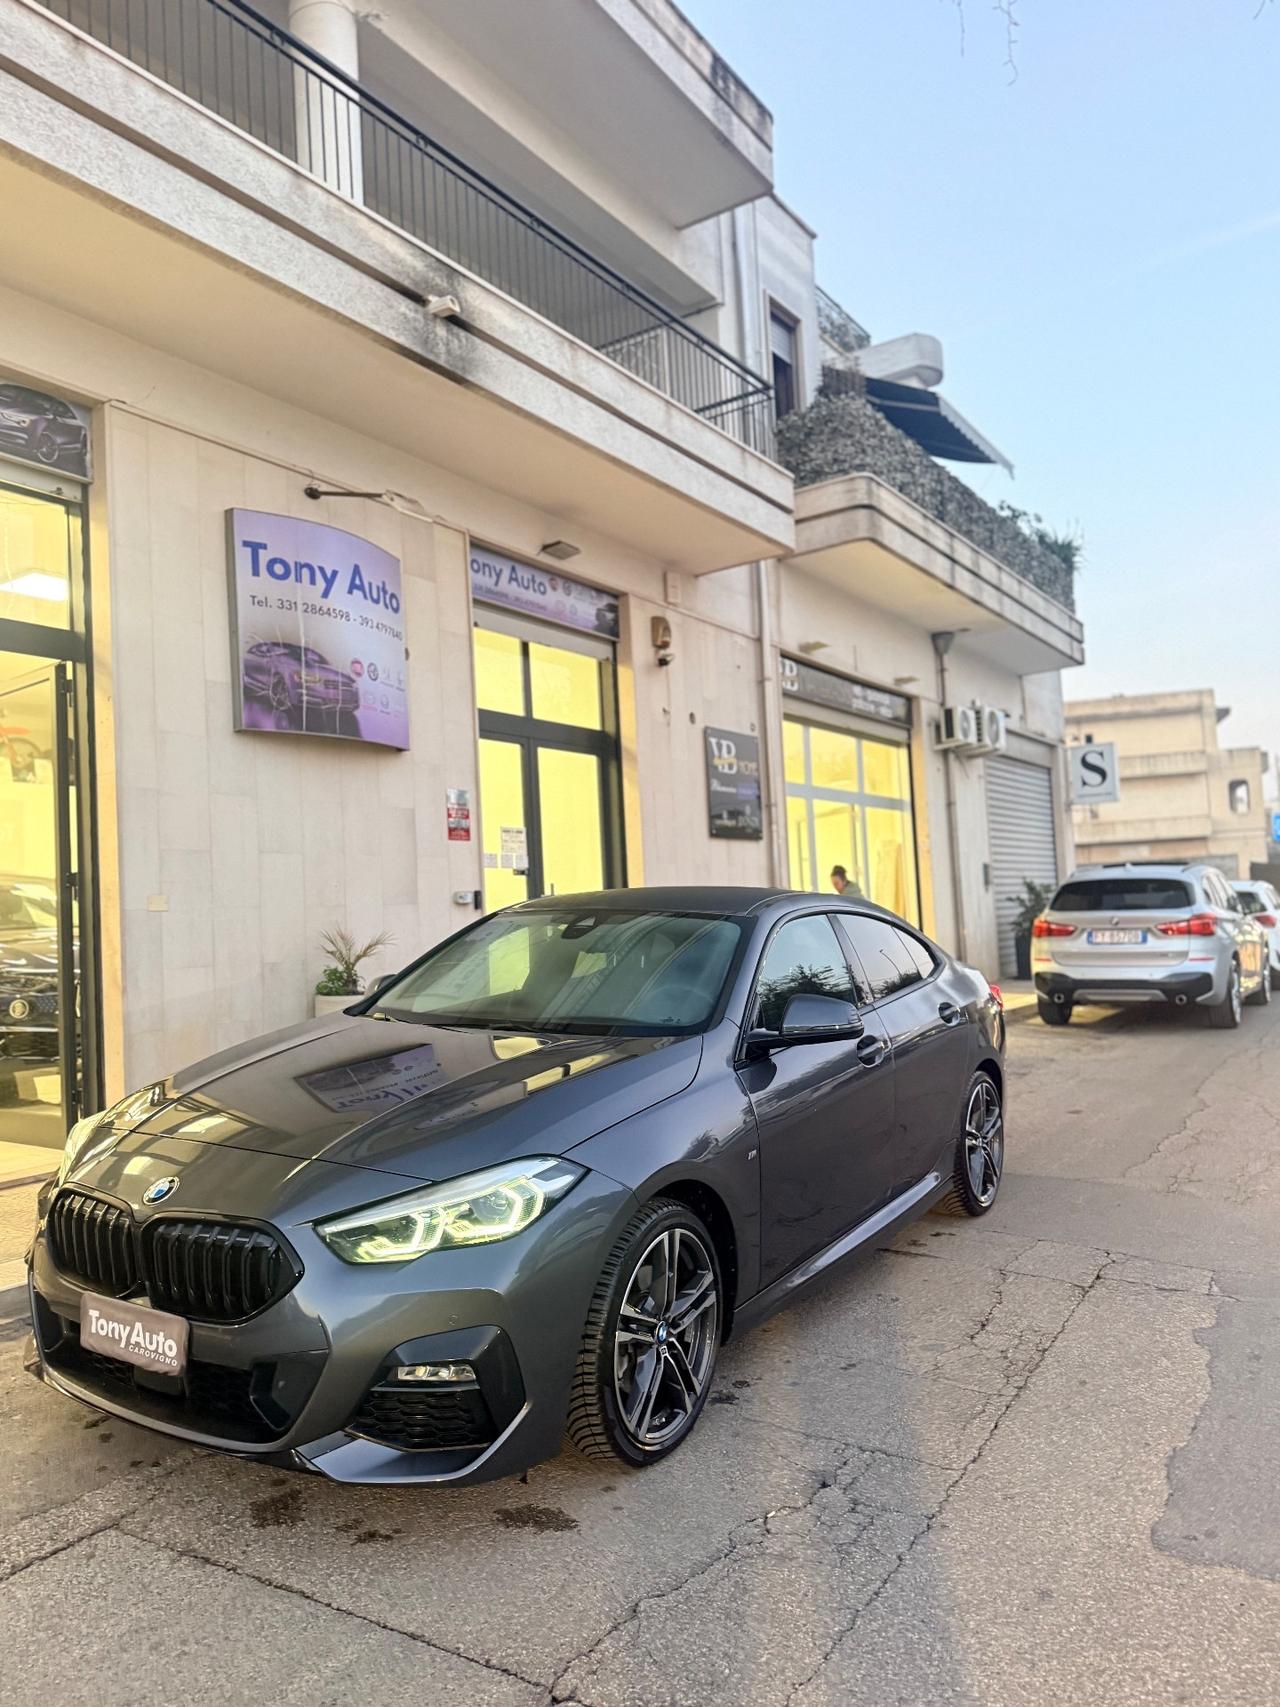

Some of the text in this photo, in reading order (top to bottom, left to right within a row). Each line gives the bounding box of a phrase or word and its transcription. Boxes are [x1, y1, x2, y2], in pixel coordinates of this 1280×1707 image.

[242, 540, 401, 614] Tony Auto
[508, 564, 548, 596] Auto
[249, 594, 273, 608] Tel.
[277, 598, 298, 612] 331
[302, 602, 351, 622] 2864598
[1080, 749, 1108, 788] S
[128, 1344, 178, 1367] CAROVIGNO
